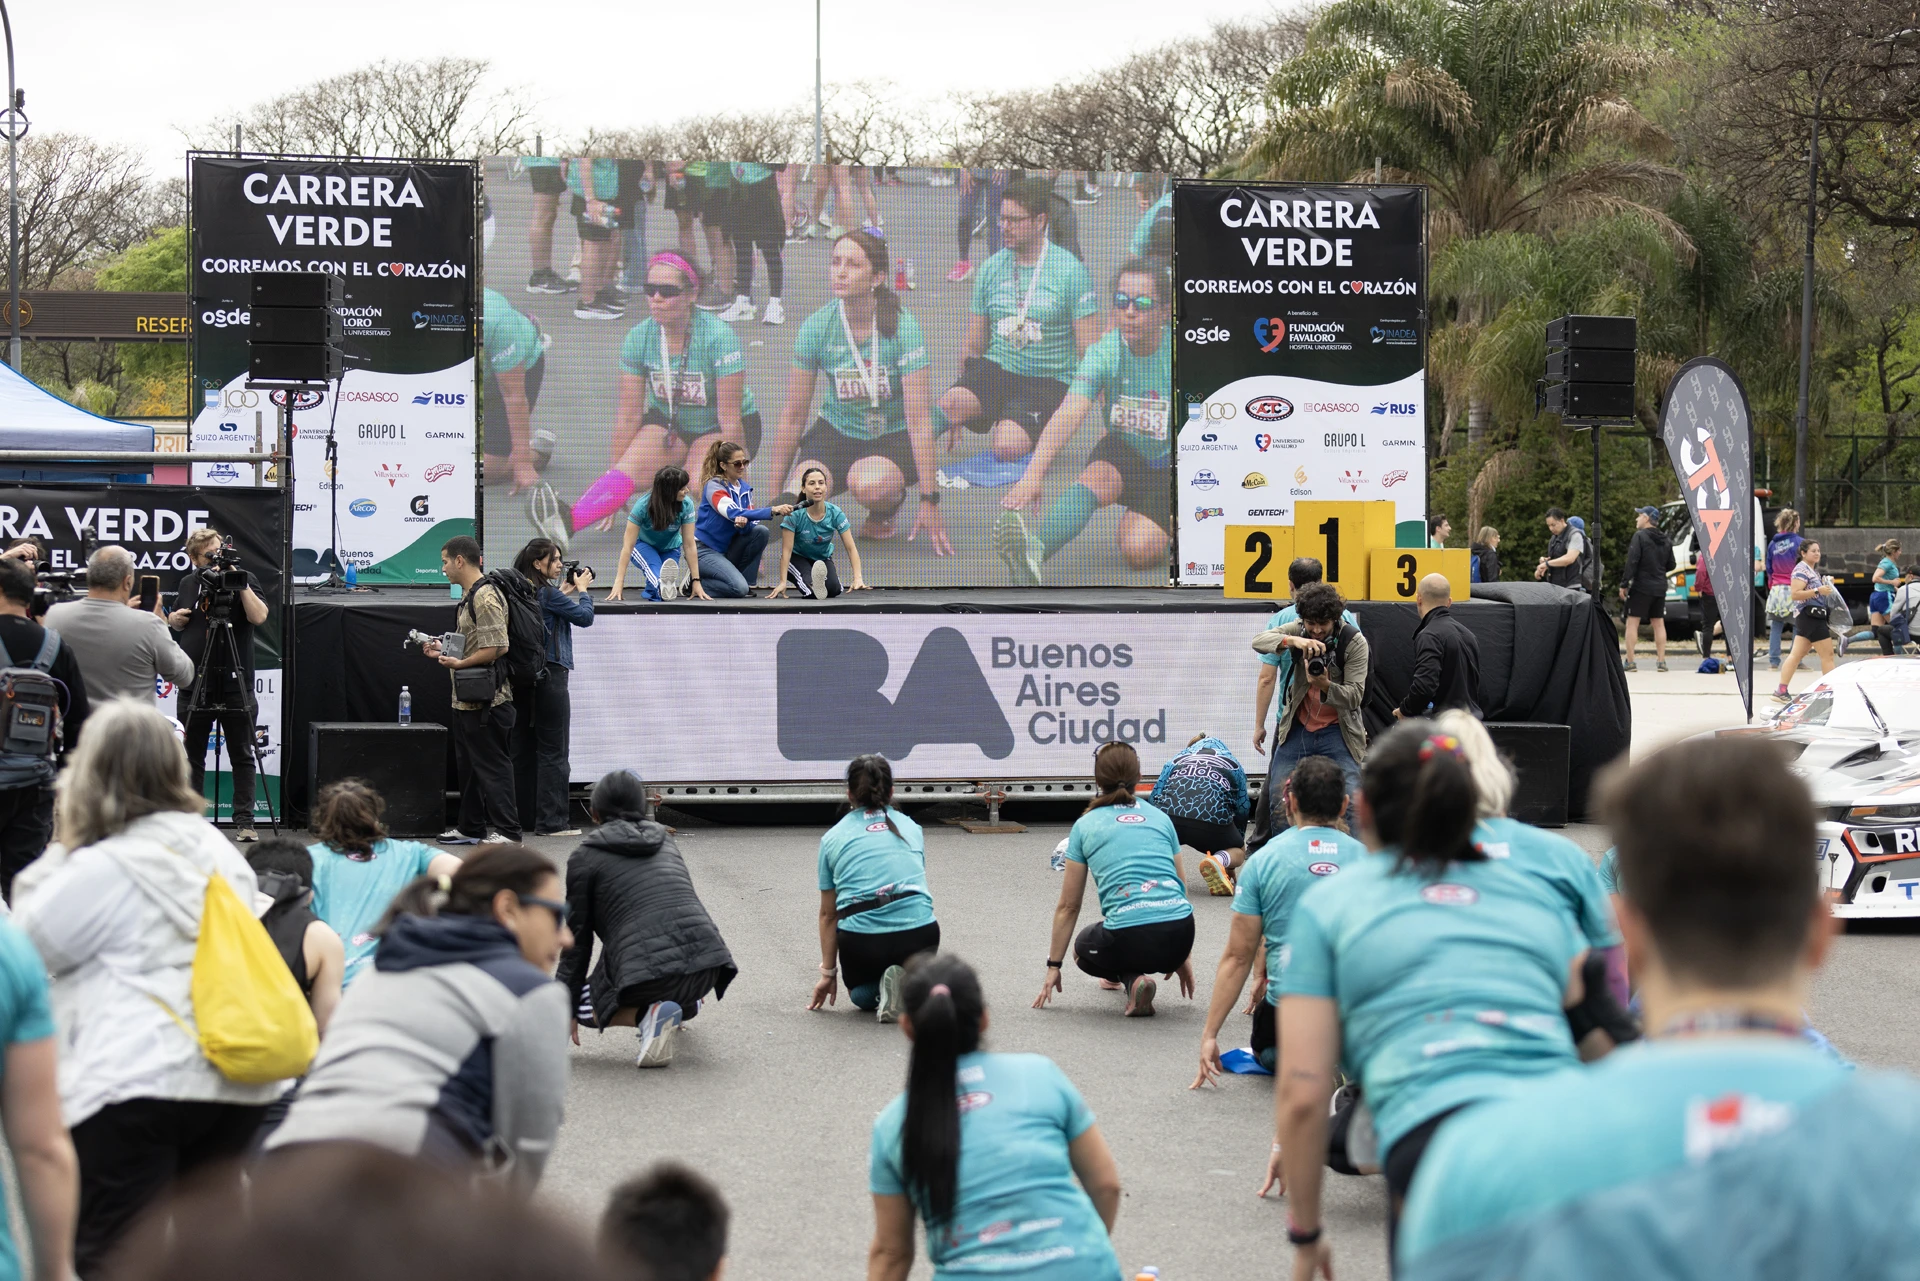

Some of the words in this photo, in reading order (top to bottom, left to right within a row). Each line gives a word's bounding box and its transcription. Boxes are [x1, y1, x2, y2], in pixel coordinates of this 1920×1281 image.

[243, 172, 424, 208] CARRERA
[1220, 199, 1380, 229] CARRERA
[266, 214, 392, 247] VERDE
[1241, 237, 1353, 267] VERDE
[201, 258, 301, 274] CORREMOS
[307, 261, 347, 276] CON
[353, 262, 372, 276] EL
[1184, 279, 1274, 294] CORREMOS
[1278, 280, 1313, 294] CON
[1318, 281, 1336, 294] EL
[202, 307, 250, 328] osde
[430, 315, 466, 324] INADEA
[1289, 321, 1345, 333] FUNDACIÓN
[1386, 329, 1417, 339] INADEA
[1184, 325, 1231, 345] osde
[1289, 333, 1336, 342] FAVALORO
[224, 390, 259, 408] 100
[347, 391, 399, 402] CASASCO
[434, 393, 465, 405] RUS
[1205, 403, 1237, 420] 100
[1256, 402, 1282, 414] ACTC
[1314, 403, 1360, 413] CASASCO
[1390, 404, 1416, 414] RUS
[358, 424, 396, 439] GRUPO
[400, 425, 406, 439] L
[1324, 433, 1357, 447] GRUPO
[1361, 433, 1366, 447] L
[374, 470, 410, 478] Villavicencio
[1245, 478, 1265, 487] McCain
[1290, 488, 1312, 496] Edison
[351, 504, 376, 512] ARCOR
[1319, 517, 1339, 583] 1
[52, 550, 78, 568] EL
[1244, 531, 1272, 593] 2
[356, 566, 382, 575] iudad
[1396, 554, 1417, 597] 3
[991, 637, 1134, 669] Buenos
[1015, 674, 1122, 707] Aires
[18, 712, 44, 726] LiveU
[1028, 709, 1166, 745] Ciudad
[1168, 764, 1231, 792] adidas
[1308, 846, 1338, 855] RUNN
